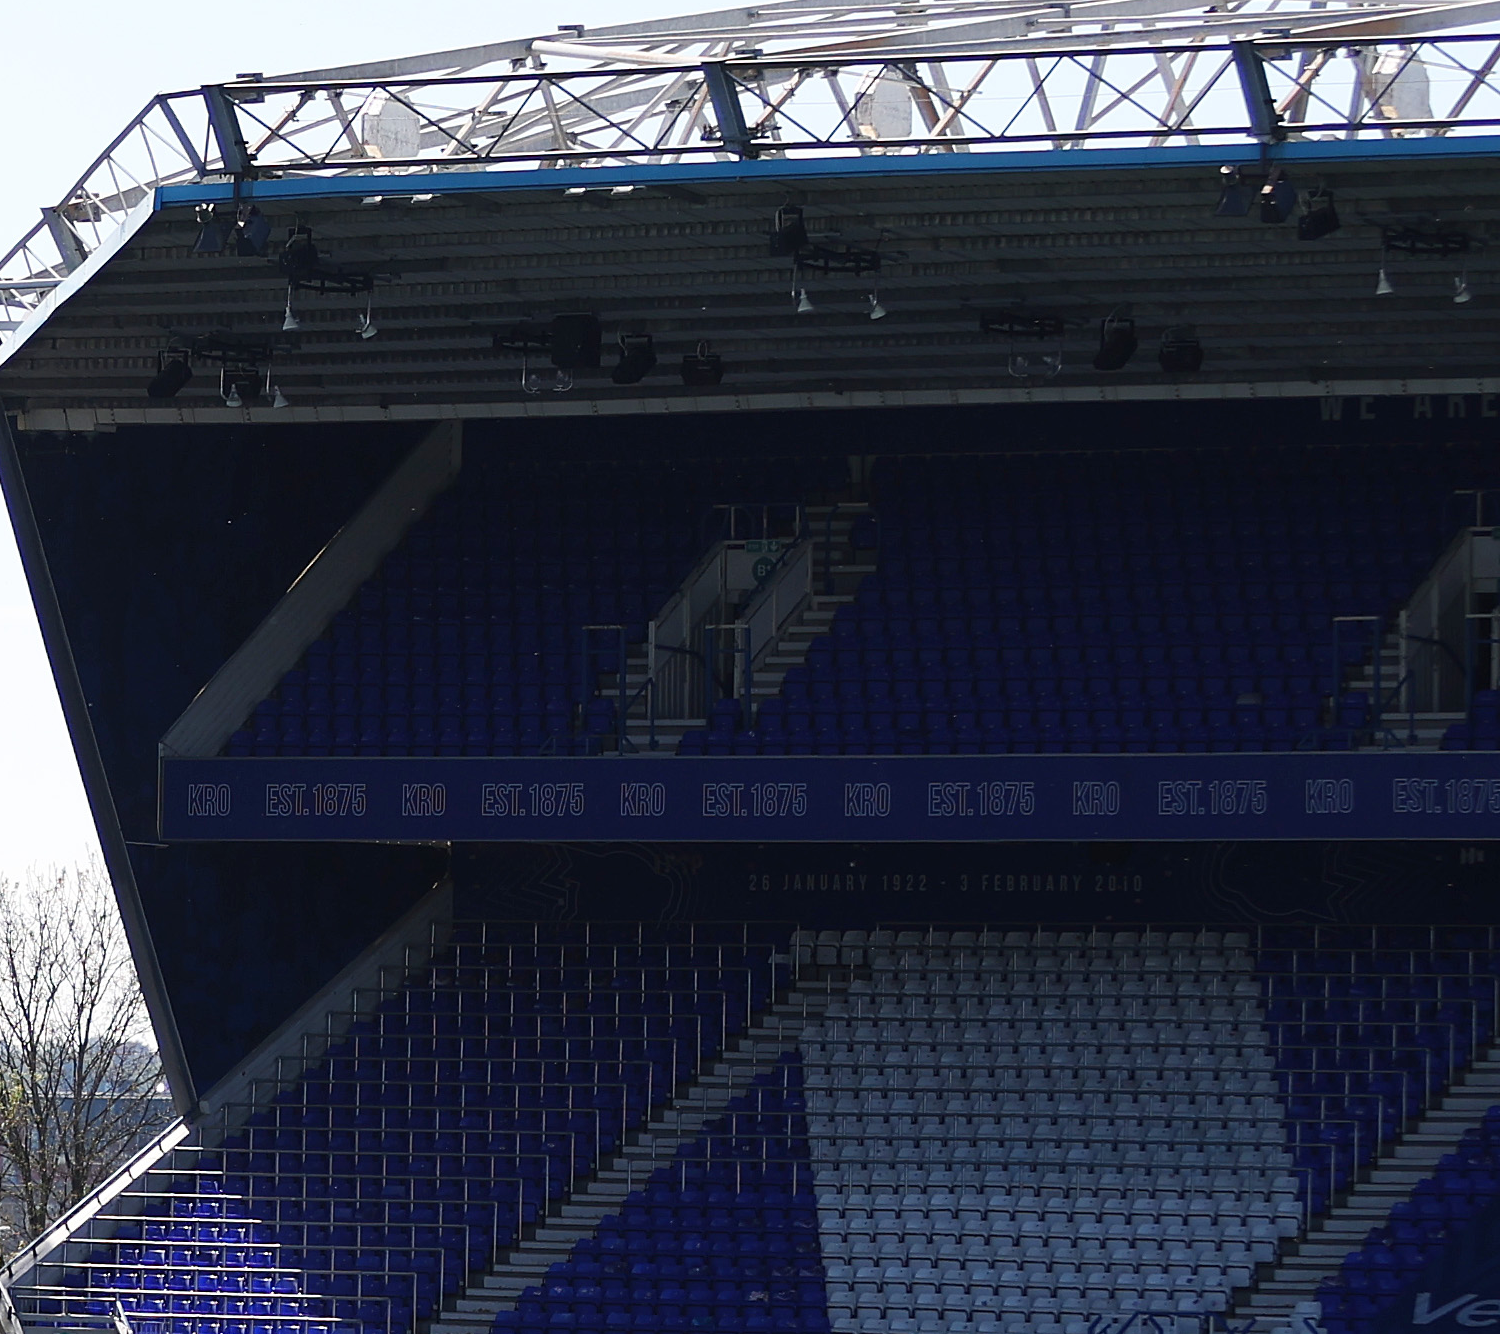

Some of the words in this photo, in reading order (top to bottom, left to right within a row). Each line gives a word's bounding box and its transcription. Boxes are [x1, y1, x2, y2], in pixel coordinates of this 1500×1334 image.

[188, 783, 231, 816] KRO
[402, 783, 446, 816] KRO
[620, 783, 664, 816] KRO
[844, 783, 890, 816] KRO
[1072, 782, 1120, 816] KRO
[1305, 779, 1353, 814] KRO
[749, 875, 770, 892] 26
[783, 875, 868, 892] JANUARY
[882, 875, 927, 892] 1922
[960, 875, 968, 892] 3
[981, 875, 1083, 892] FEBRUARY
[1095, 875, 1142, 892] 2010
